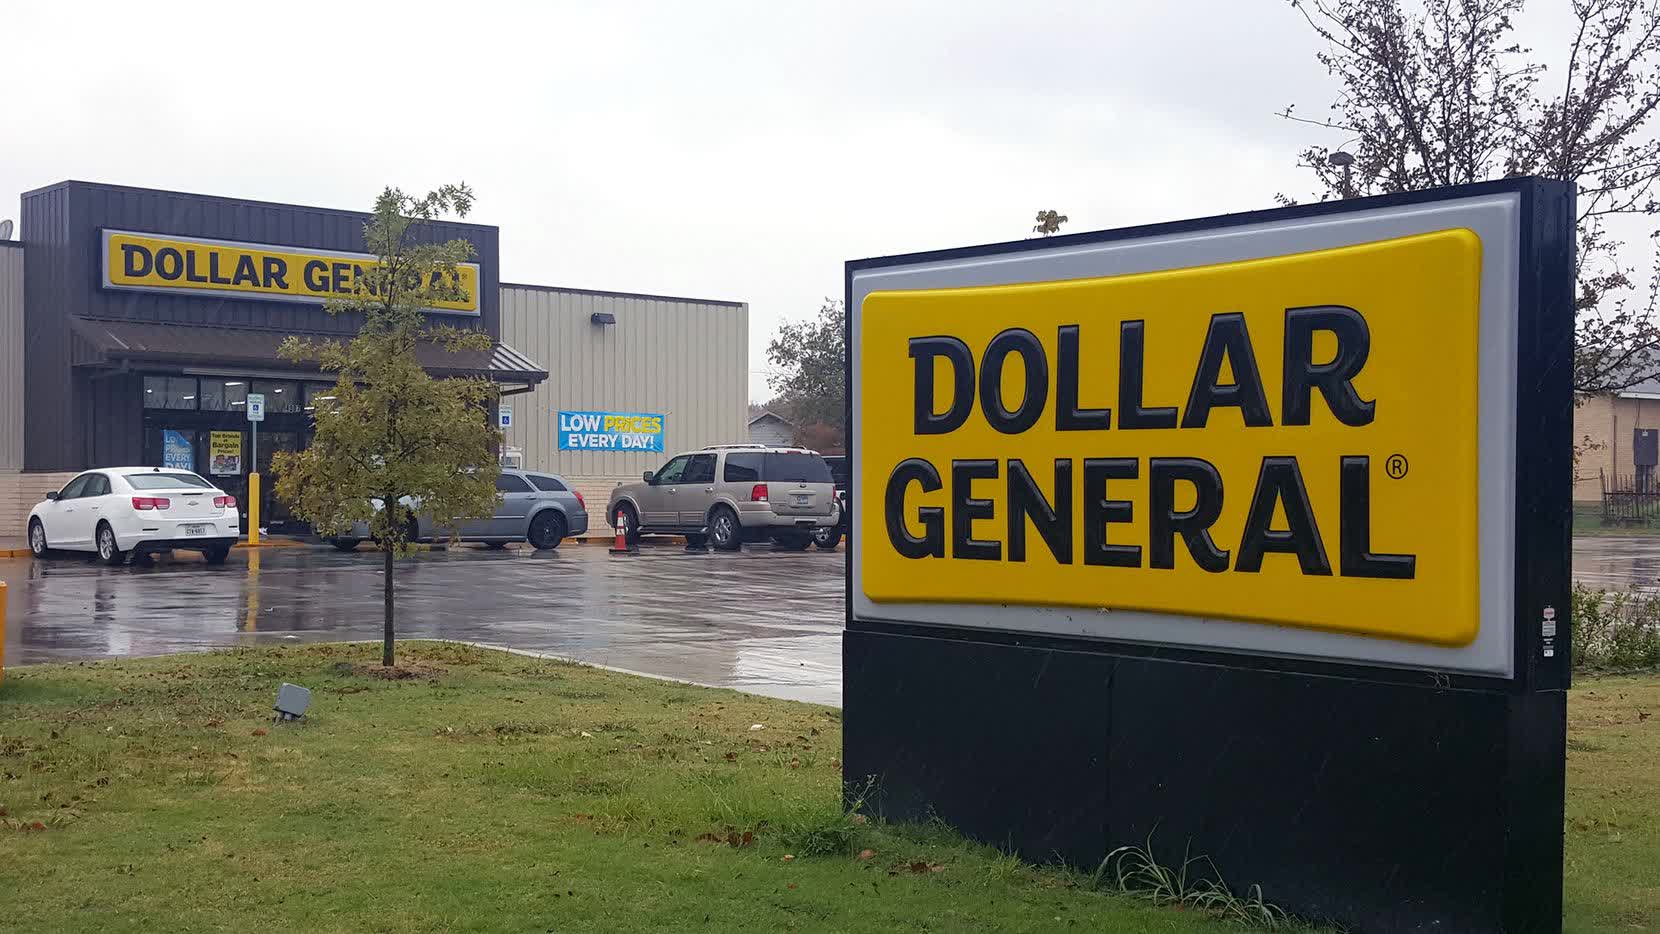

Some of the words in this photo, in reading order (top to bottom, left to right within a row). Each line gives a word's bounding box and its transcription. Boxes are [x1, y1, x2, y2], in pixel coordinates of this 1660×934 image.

[121, 243, 289, 290] DOLLAR
[303, 259, 470, 303] GENAL
[908, 304, 1377, 435] DOLLAR
[561, 414, 601, 432] LOW
[604, 415, 661, 434] PRICES
[568, 433, 619, 448] EVERY
[622, 433, 655, 449] DAY!
[166, 453, 191, 462] EVERY
[884, 454, 1417, 580] GENERAL
